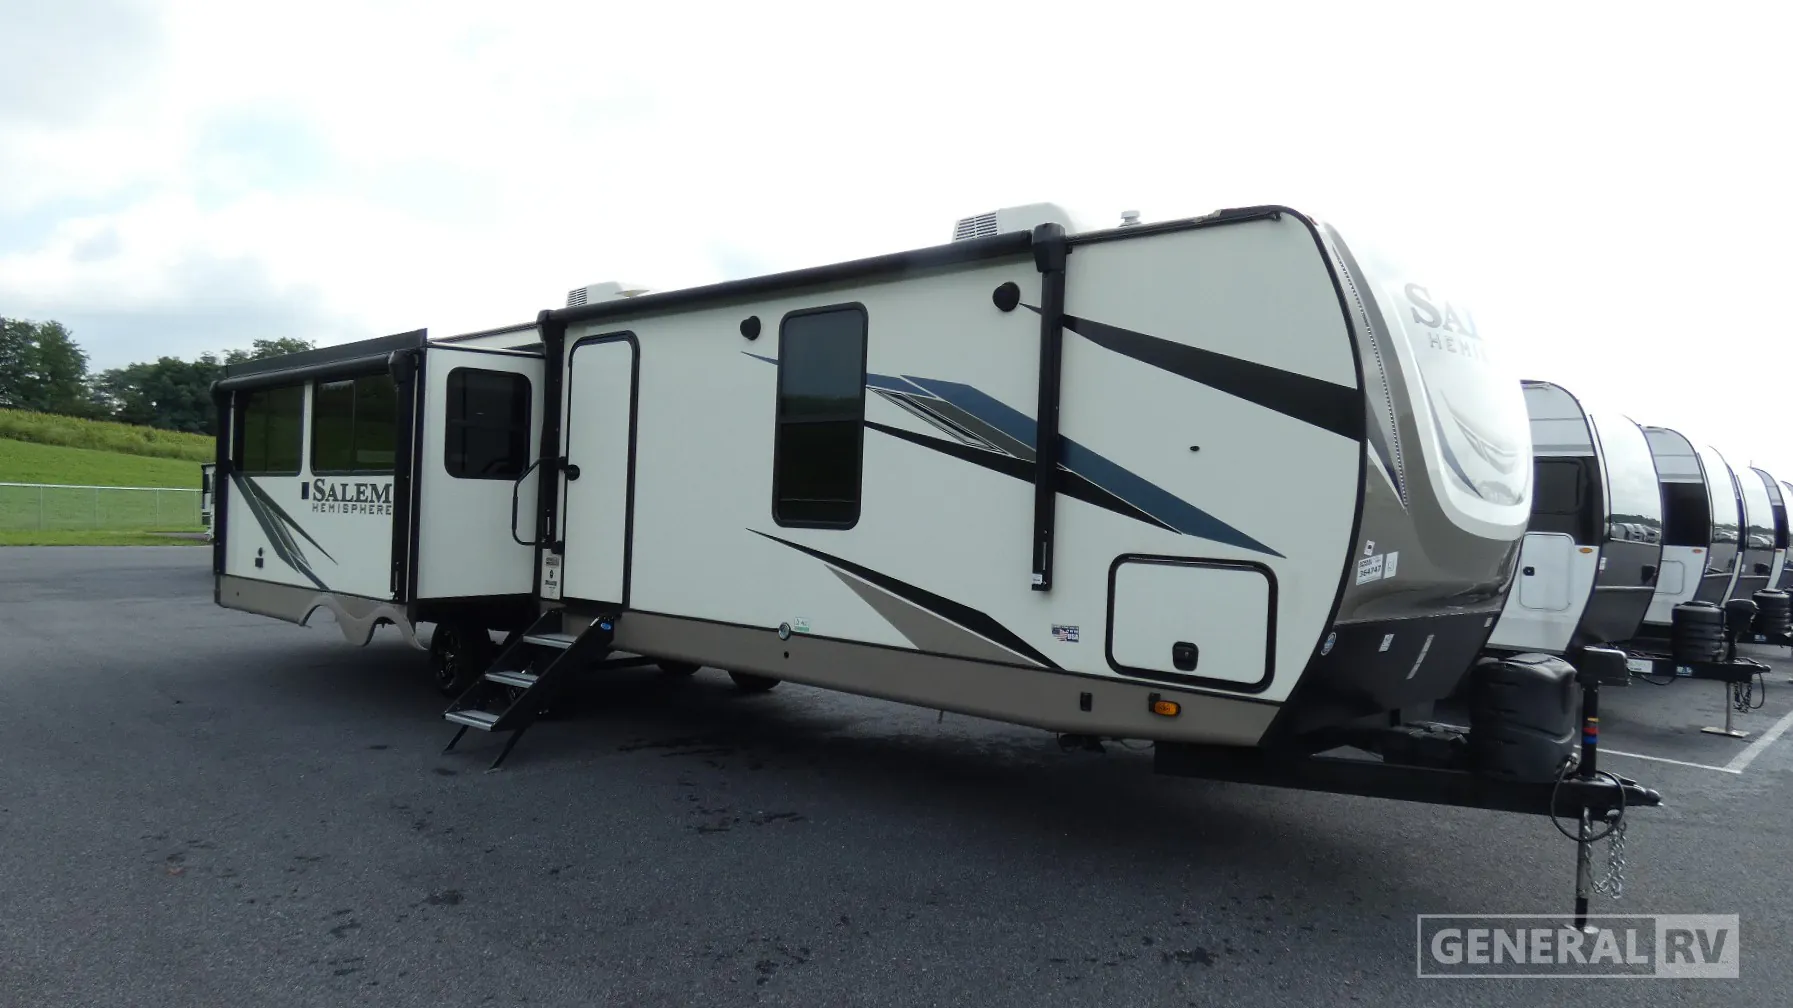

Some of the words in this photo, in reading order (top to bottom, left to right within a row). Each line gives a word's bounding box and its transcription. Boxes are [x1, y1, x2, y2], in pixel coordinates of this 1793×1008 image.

[1404, 282, 1482, 341] SAL
[312, 478, 393, 503] SALEM
[312, 503, 392, 515] HEMISPHERE
